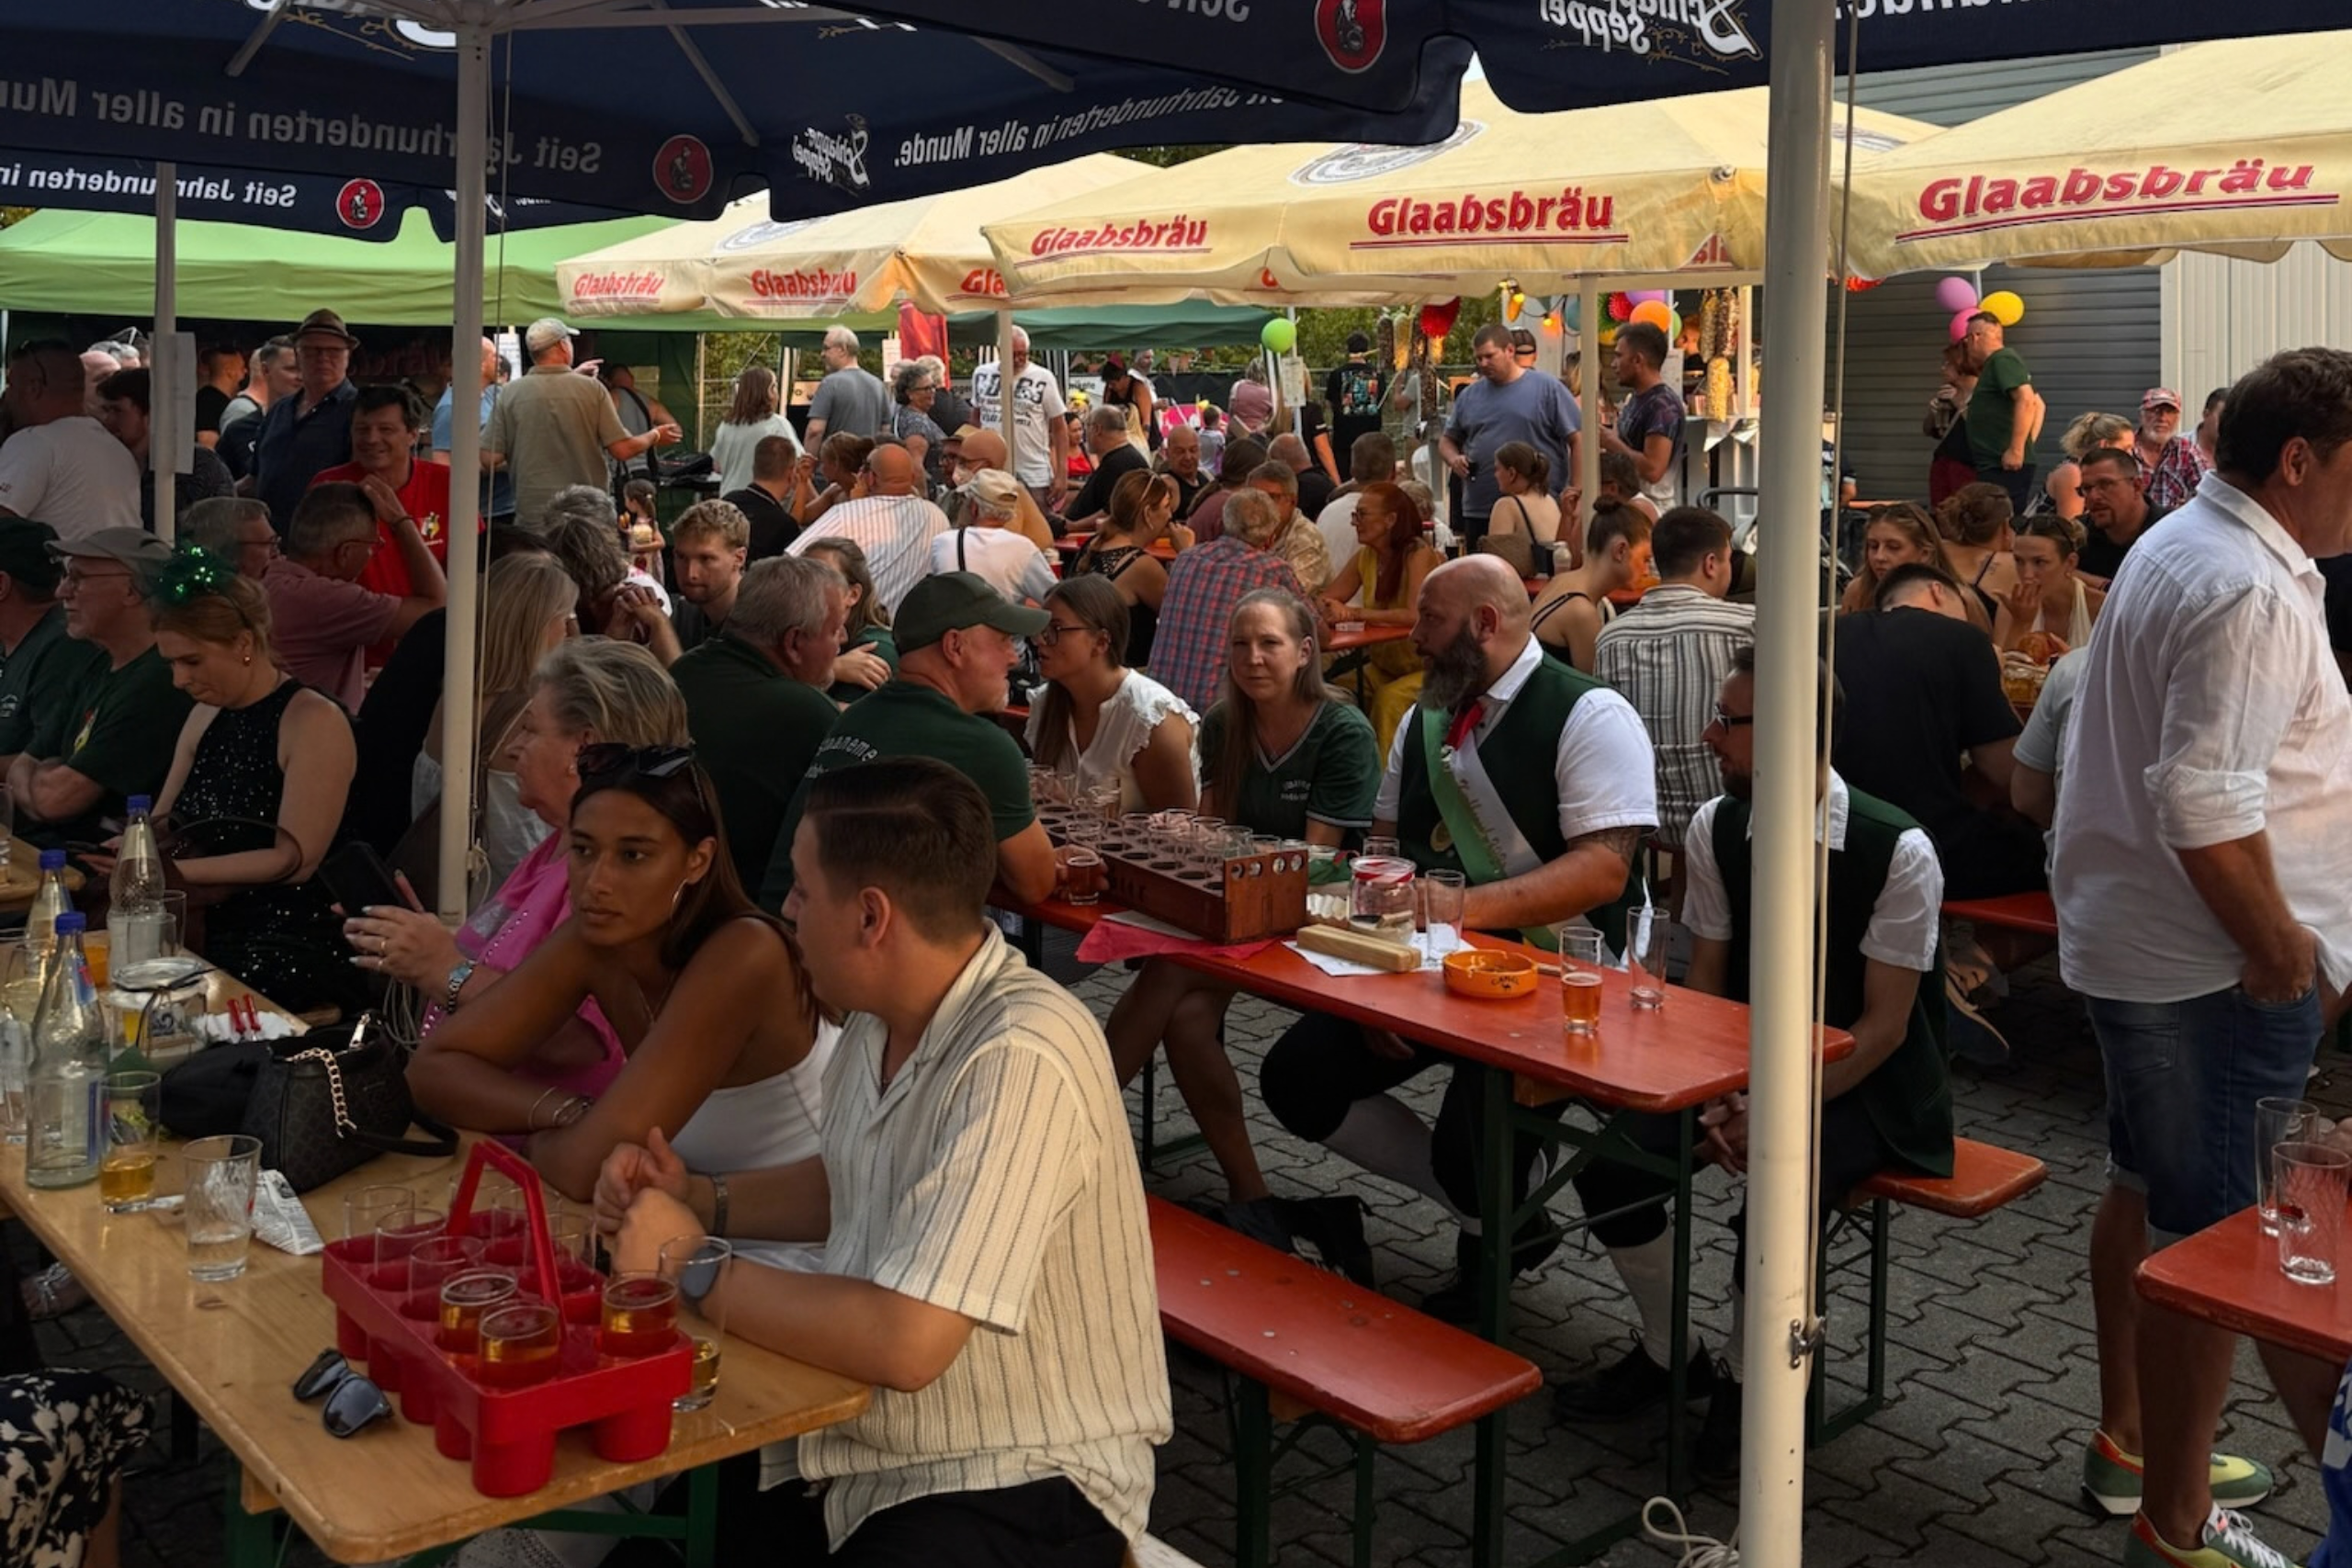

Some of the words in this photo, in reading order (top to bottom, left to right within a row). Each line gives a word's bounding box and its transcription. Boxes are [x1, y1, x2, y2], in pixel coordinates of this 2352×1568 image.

[1368, 186, 1614, 236] Glaabsbräu
[1918, 158, 2316, 223] Glaabsbräu
[1031, 214, 1209, 257] Glaabsbräu
